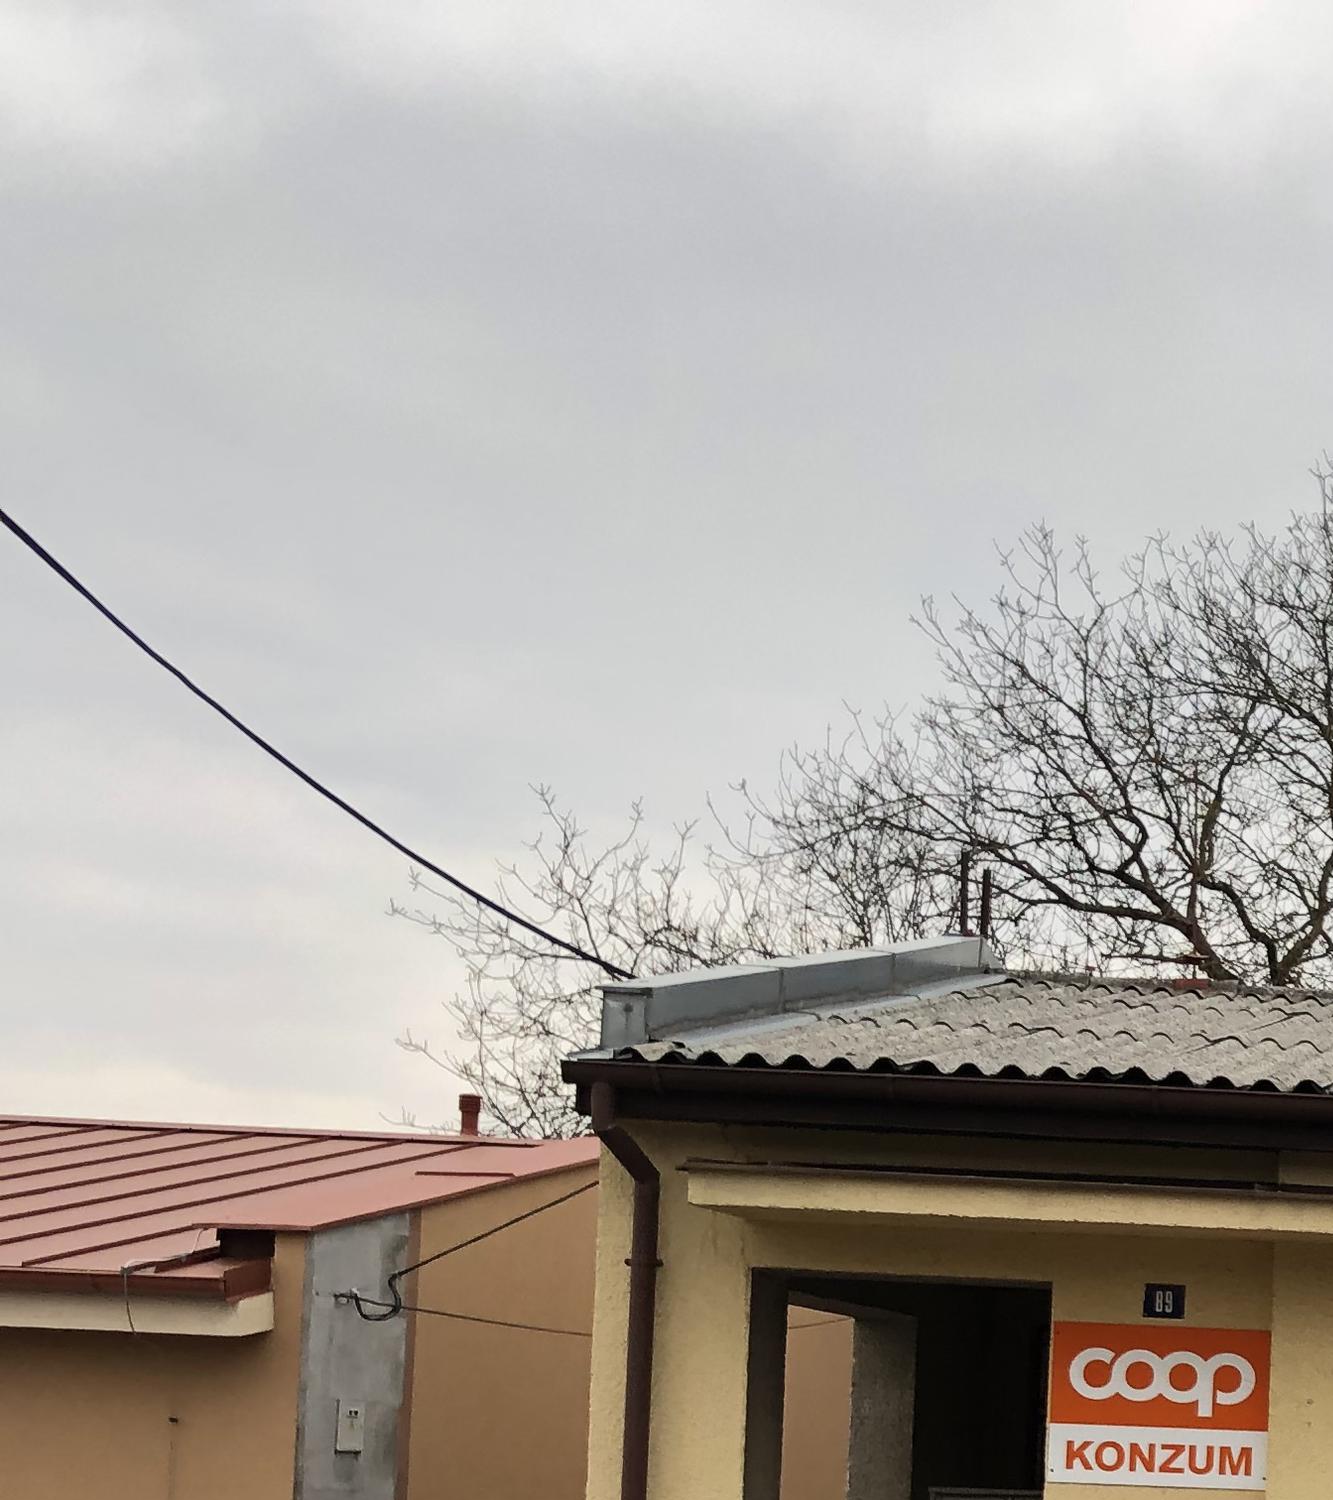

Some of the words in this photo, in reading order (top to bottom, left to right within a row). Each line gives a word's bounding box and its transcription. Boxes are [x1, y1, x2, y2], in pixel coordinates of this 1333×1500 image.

[1155, 1290, 1173, 1313] 89
[1068, 1346, 1257, 1418] coop
[1064, 1439, 1253, 1477] KONZUM
